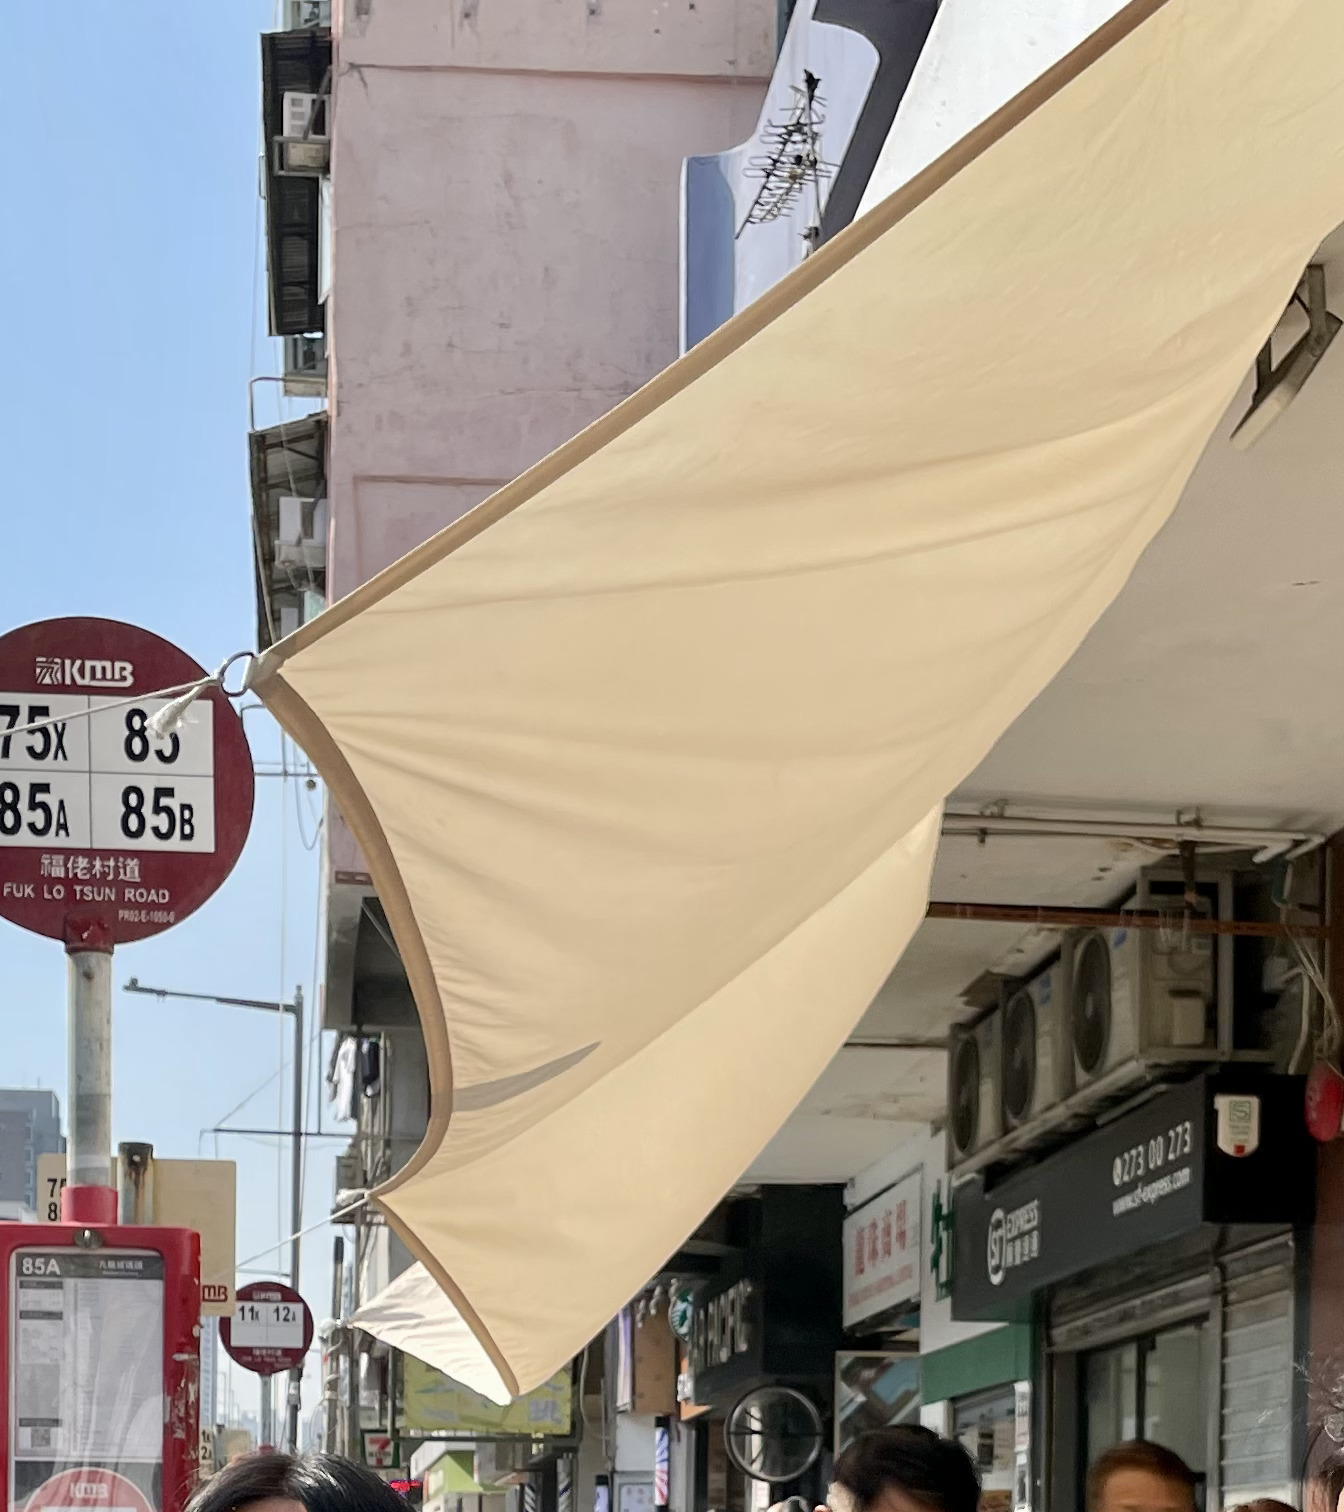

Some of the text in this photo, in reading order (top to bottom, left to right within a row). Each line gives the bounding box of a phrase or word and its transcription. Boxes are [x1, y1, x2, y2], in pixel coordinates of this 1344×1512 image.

[64, 659, 134, 688] KMB
[121, 785, 195, 841] 85B
[40, 853, 141, 883] 福佬村道
[3, 883, 170, 904] FUK LO TSUN ROAD
[1168, 1120, 1192, 1161] 273
[22, 1257, 60, 1275] 85A
[202, 1284, 228, 1303] MB
